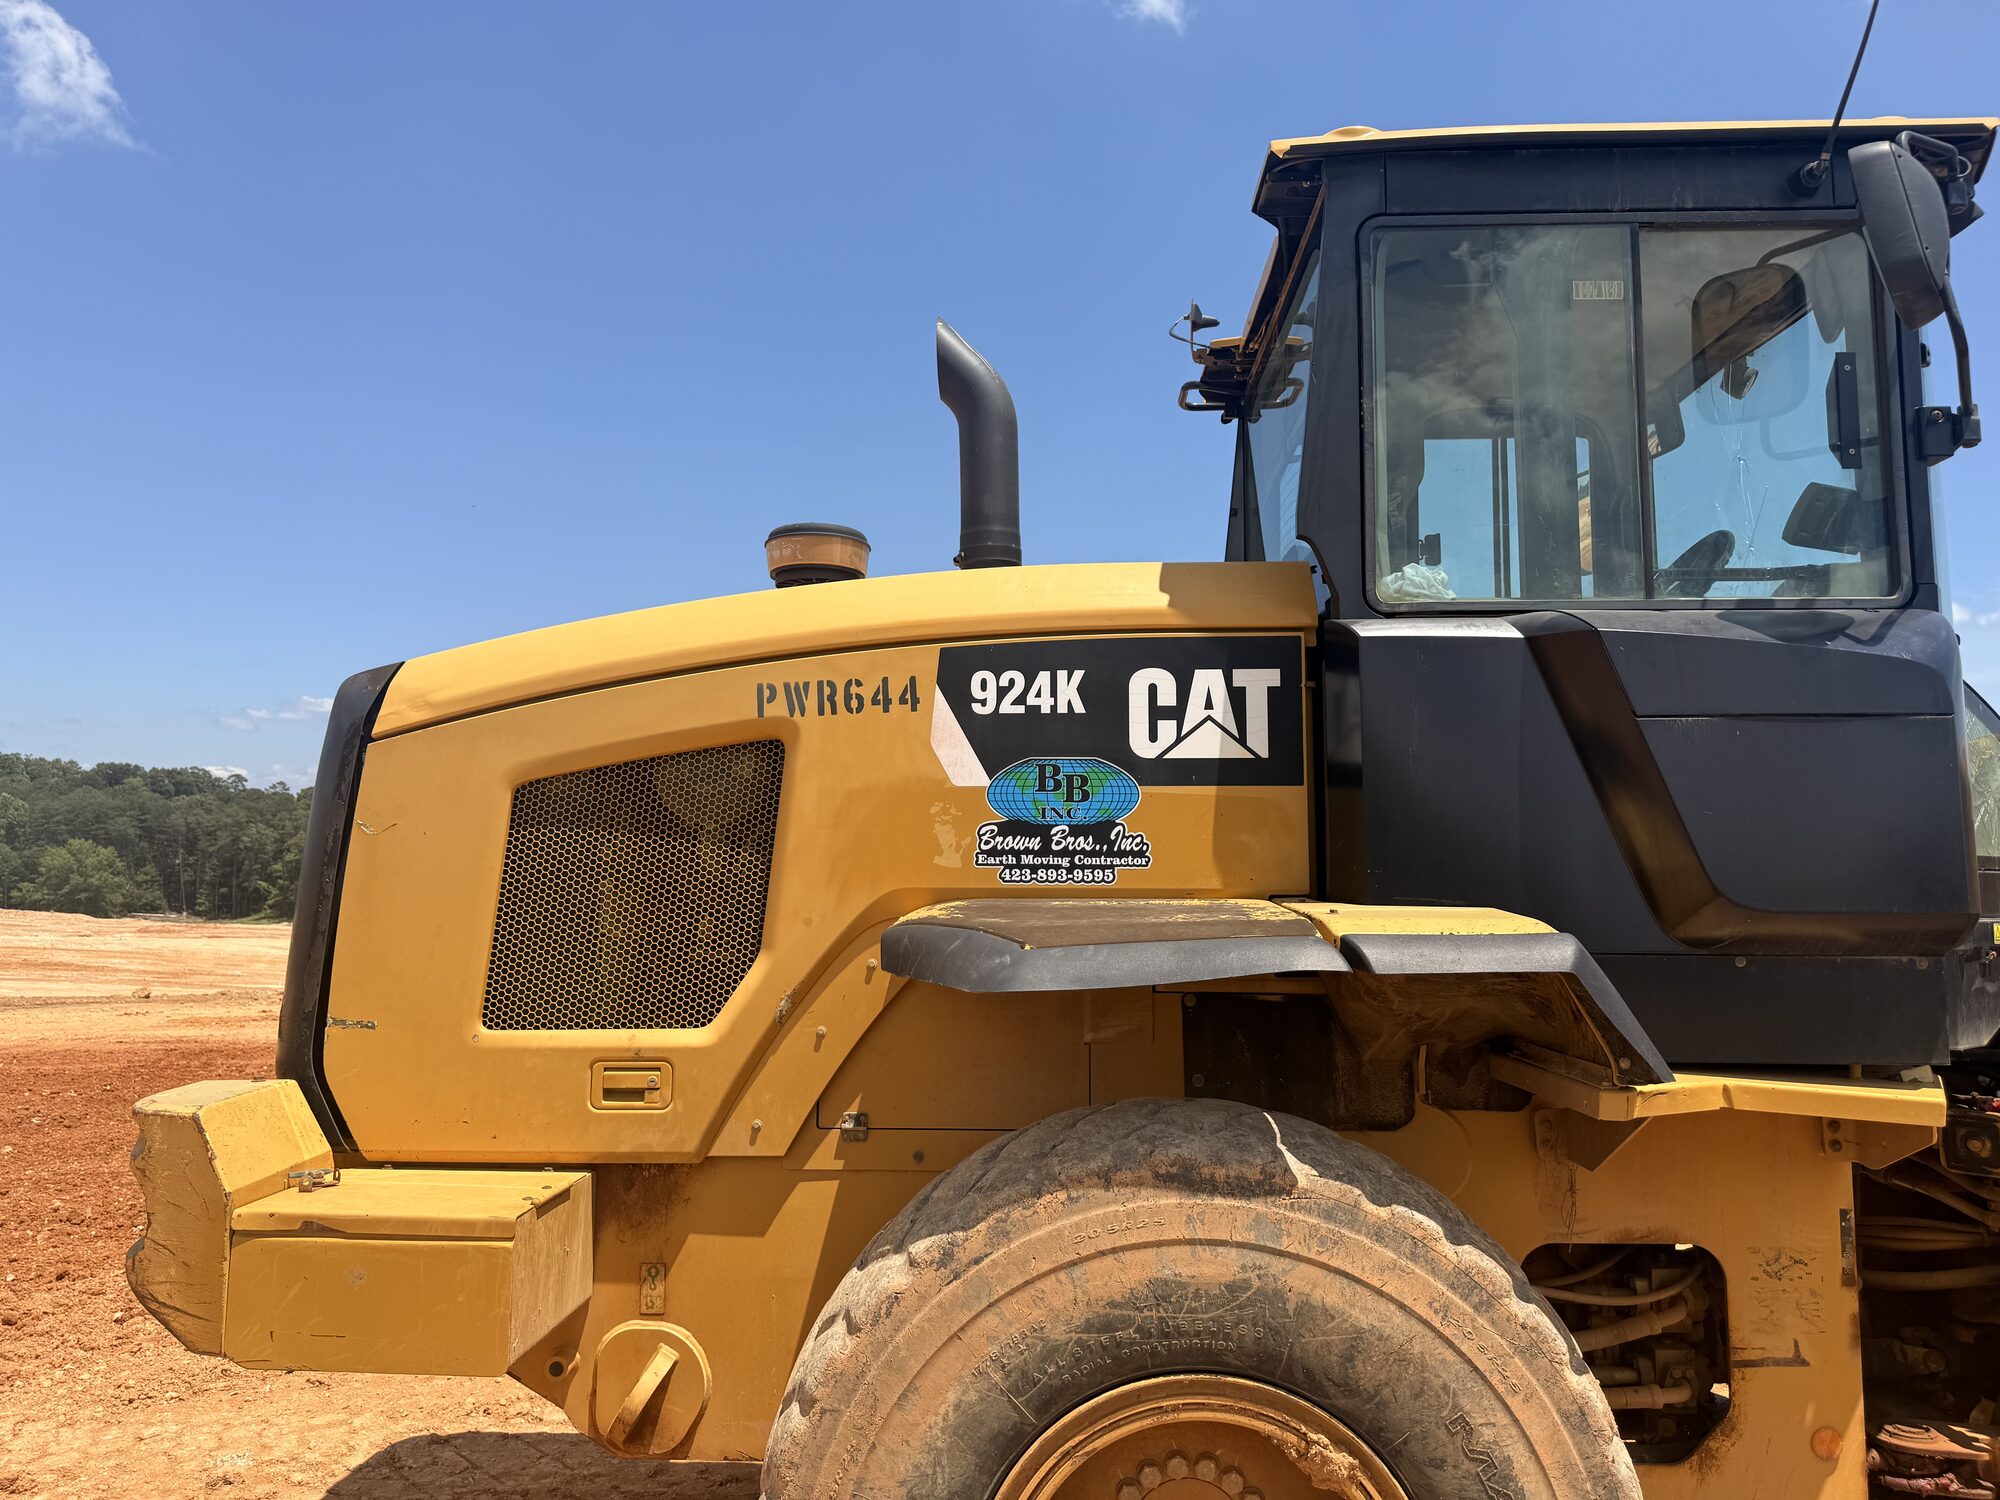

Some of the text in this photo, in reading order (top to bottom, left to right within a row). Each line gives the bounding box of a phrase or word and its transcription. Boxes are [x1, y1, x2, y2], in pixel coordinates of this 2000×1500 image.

[756, 675, 921, 718] PWR644
[970, 669, 1086, 715] 924K
[1128, 667, 1281, 759] CAT
[1035, 763, 1091, 803] BB
[1039, 806, 1088, 820] INC.
[979, 825, 1148, 852] Brown Bros., Inc.
[977, 854, 1149, 867] Earth Moving Contractor
[1001, 868, 1114, 882] 423-893-9595
